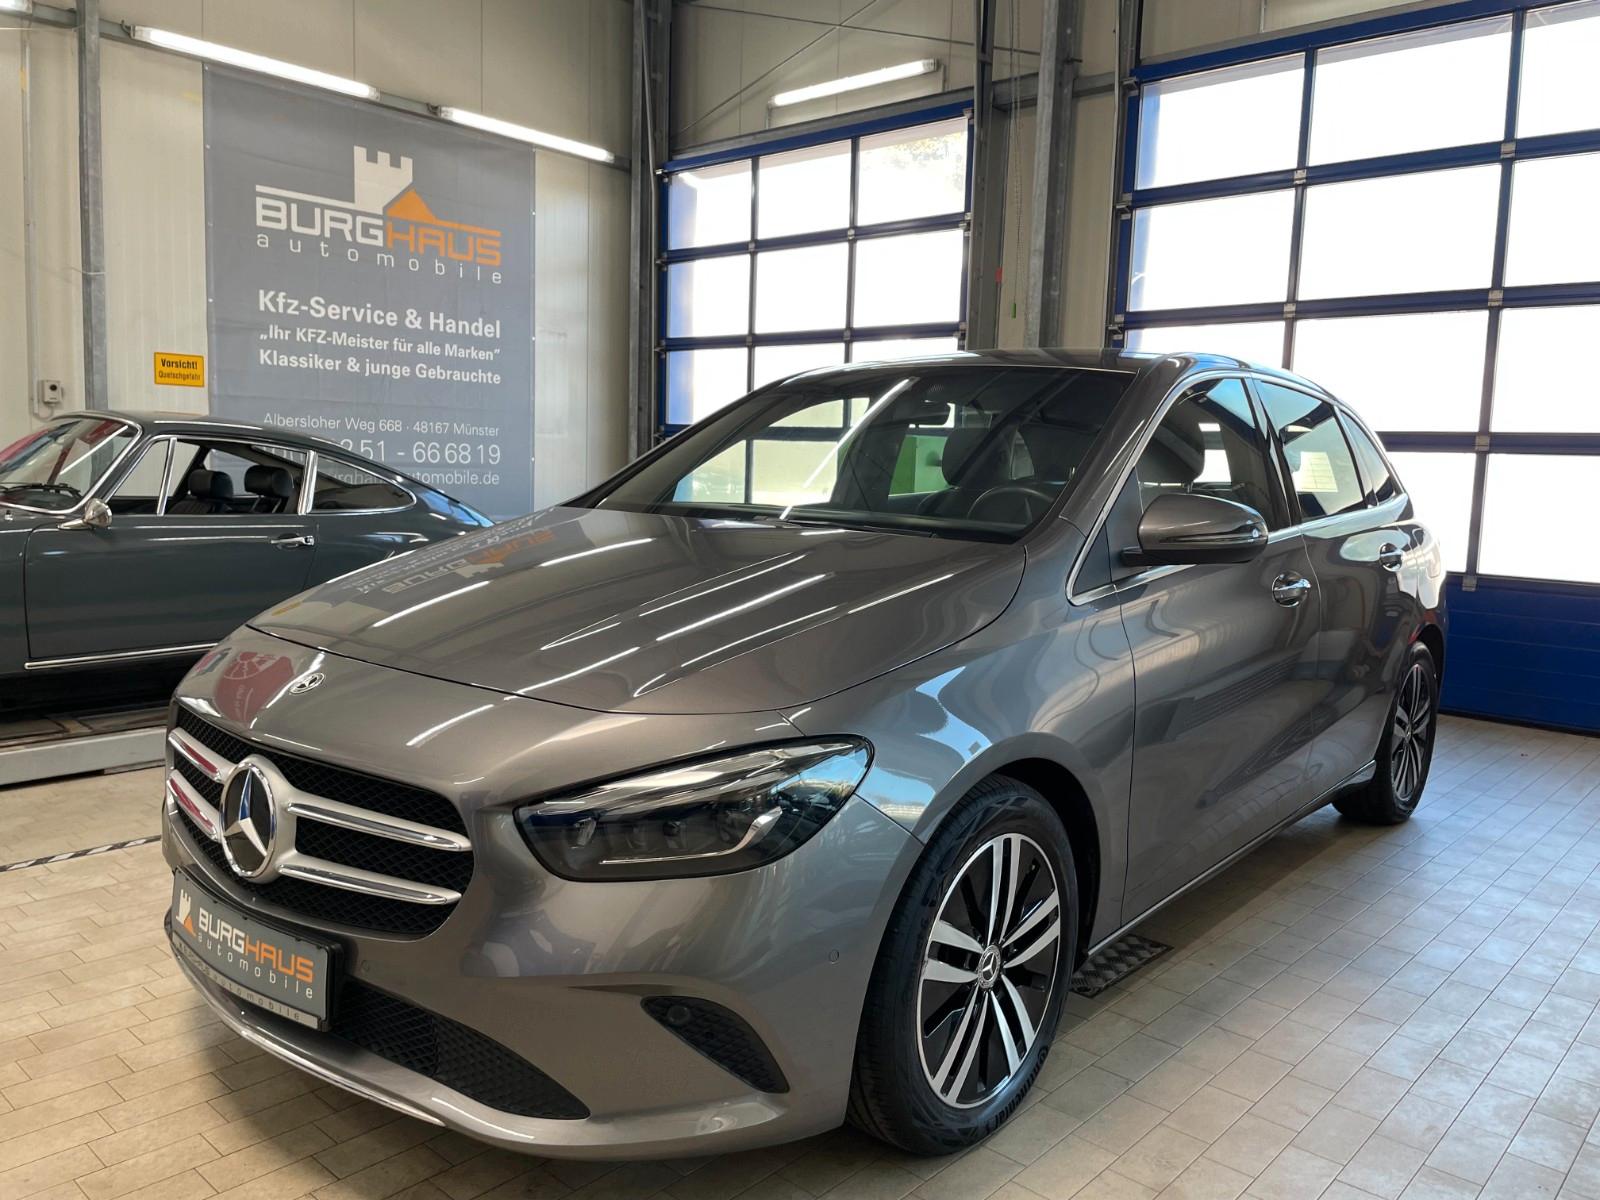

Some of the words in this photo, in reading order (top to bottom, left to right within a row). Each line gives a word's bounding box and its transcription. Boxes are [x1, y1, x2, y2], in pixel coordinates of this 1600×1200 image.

[256, 197, 501, 266] BURGHAUS
[257, 233, 501, 284] automobile
[259, 290, 398, 327] Kfz-Service
[405, 308, 422, 330] &
[430, 311, 500, 338] Handel
[161, 358, 197, 370] Vorsicht!
[296, 327, 389, 350] KFZ-Meister
[393, 338, 413, 353] für
[417, 341, 441, 355] alle
[260, 349, 341, 371] Klassiker
[347, 357, 360, 372] &
[365, 359, 411, 379] junge
[415, 363, 501, 384] Gebrauchte
[264, 413, 340, 430] Albersloher
[345, 417, 375, 433] Weg
[379, 419, 402, 432] 668
[413, 420, 449, 434] 48167
[453, 423, 499, 436] Münster
[198, 907, 314, 984] BURGHAUS
[198, 932, 313, 999] automobile
